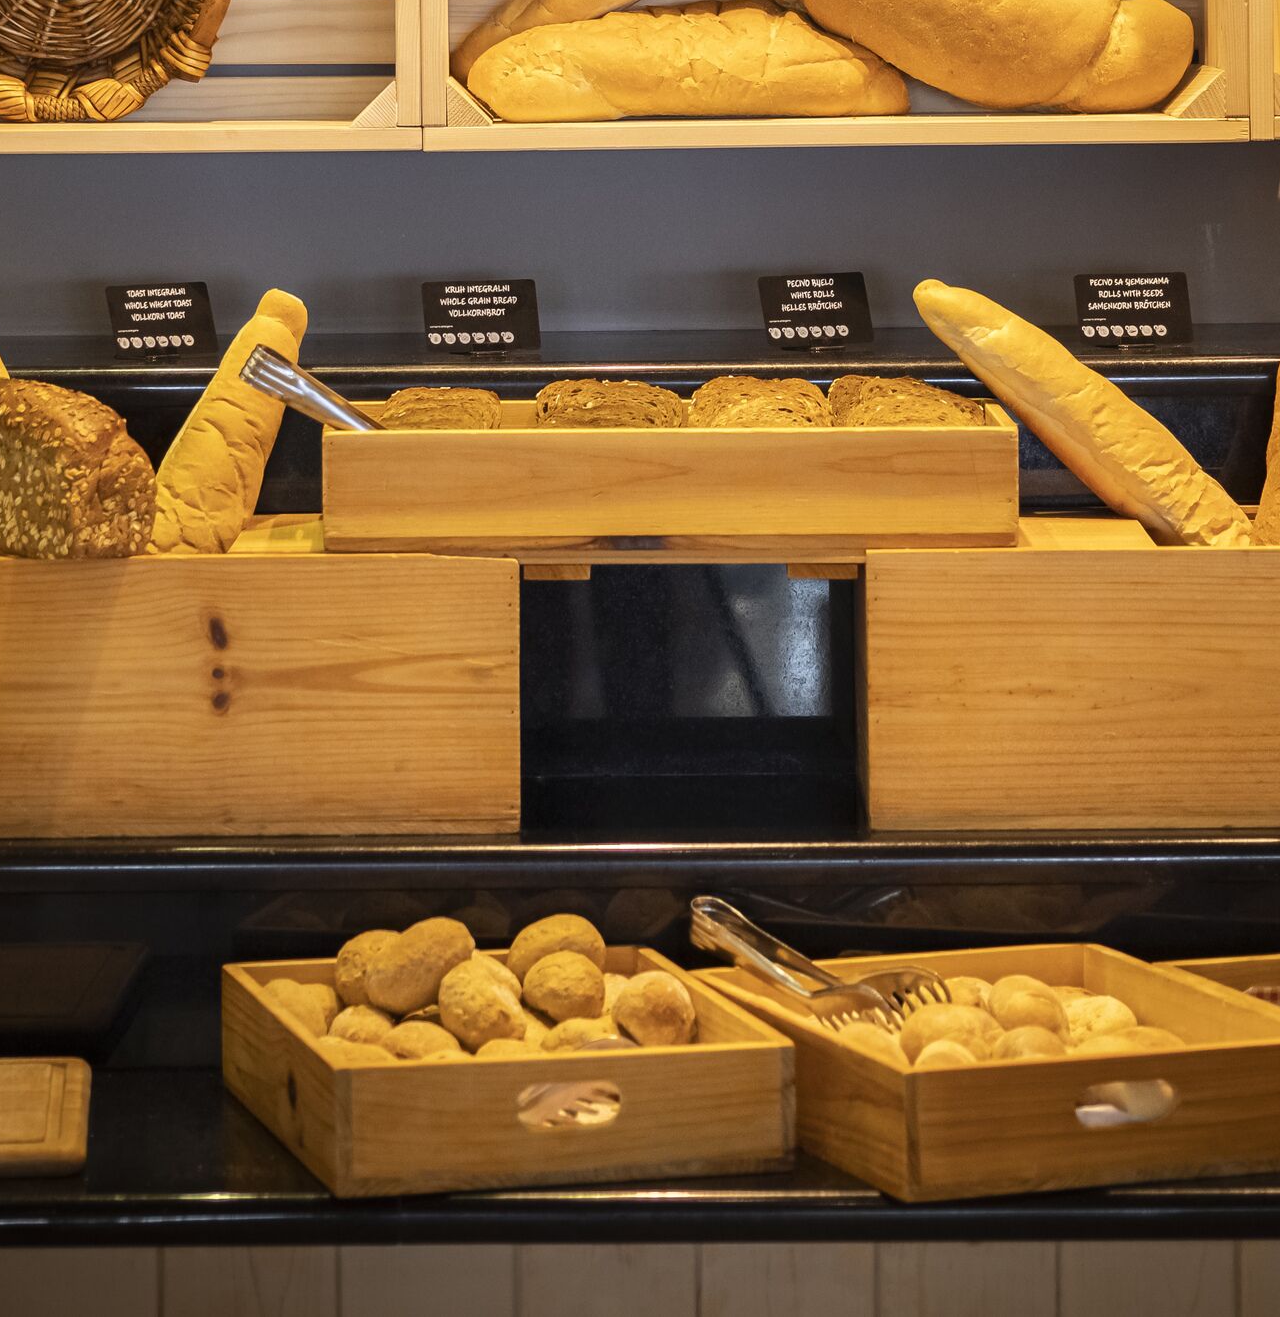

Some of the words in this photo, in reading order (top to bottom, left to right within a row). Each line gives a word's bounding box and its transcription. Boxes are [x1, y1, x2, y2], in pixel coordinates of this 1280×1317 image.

[1114, 278, 1123, 286] SA
[127, 290, 146, 298] TOAST
[148, 288, 185, 296] INTEGRALNI
[445, 285, 465, 293] KRUH
[467, 285, 509, 293] INTEGRALNI
[1099, 290, 1121, 298] ROLLS
[1123, 289, 1141, 297] WITH
[1143, 289, 1163, 297] SEEDS
[790, 291, 812, 299] WHITE
[813, 290, 835, 298] ROLLS
[125, 301, 148, 310] WHOLE
[149, 300, 172, 308] WHEAT
[173, 299, 192, 307] TOAST
[468, 297, 490, 305] GRAIN
[493, 296, 517, 304] BREAD
[1088, 302, 1132, 310] SAMENKORN
[1134, 300, 1170, 310] BRÖTCHEN
[781, 304, 806, 312] HELLES
[808, 301, 842, 311] BRÖTCHEN
[131, 312, 165, 321] VOLLKORN
[166, 311, 185, 319] TOAST
[449, 309, 505, 317] VOLLKORNBROT
